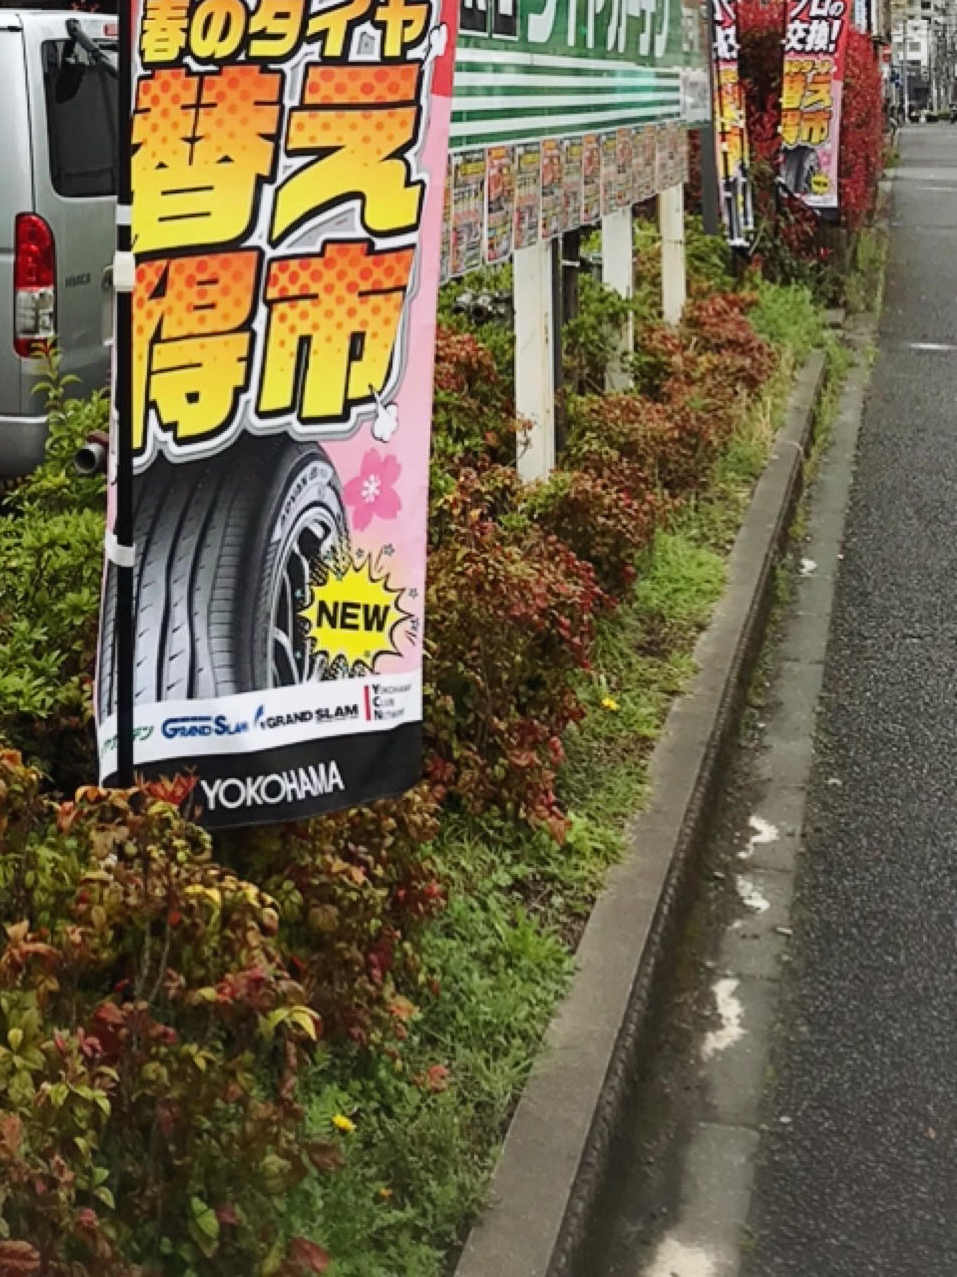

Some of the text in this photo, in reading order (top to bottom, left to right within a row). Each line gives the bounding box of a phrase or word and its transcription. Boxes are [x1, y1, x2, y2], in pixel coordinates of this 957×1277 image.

[131, 61, 425, 253] 替え
[131, 241, 417, 453] 得市
[315, 601, 391, 632] NEW
[266, 709, 313, 729] GRAND
[315, 704, 359, 722] SLAM
[200, 759, 345, 810] YOKOHAMA
